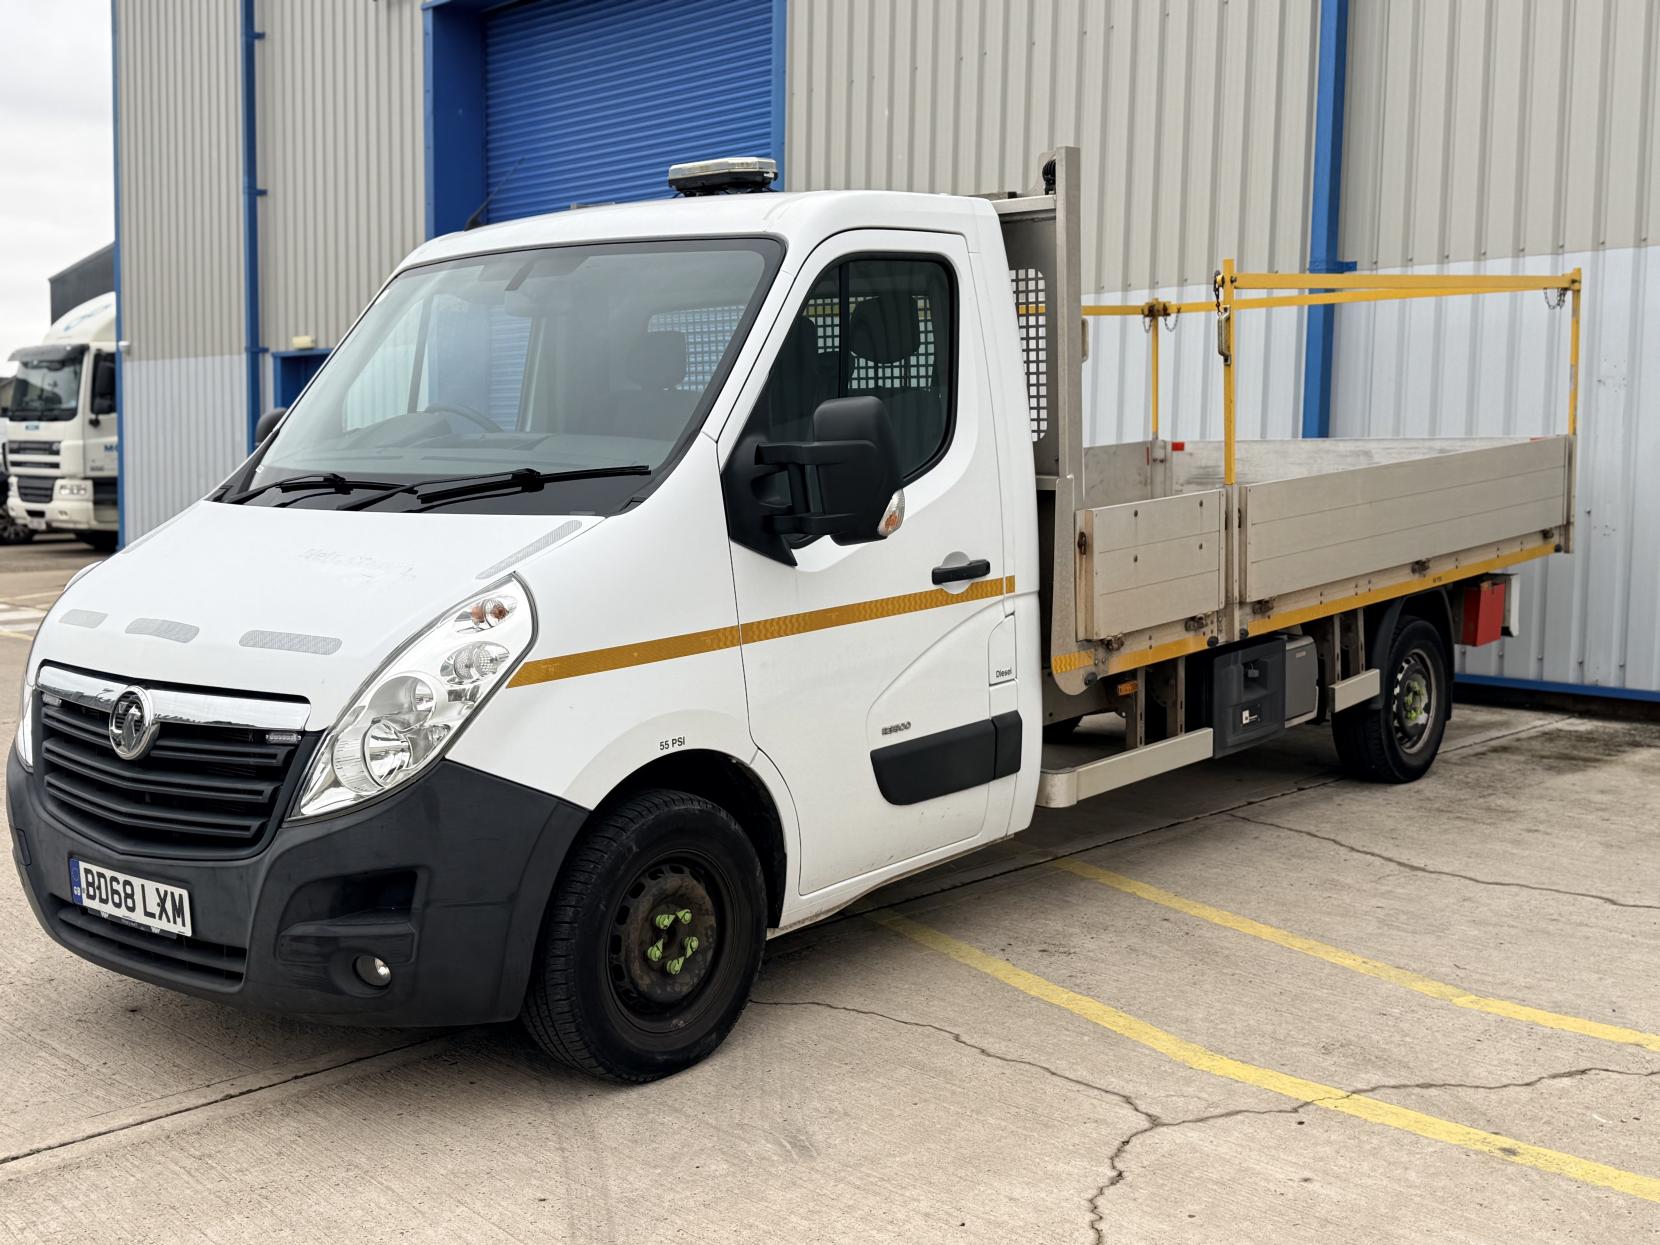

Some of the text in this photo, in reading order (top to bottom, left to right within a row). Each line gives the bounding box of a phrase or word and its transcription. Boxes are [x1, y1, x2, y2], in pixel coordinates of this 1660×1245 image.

[996, 667, 1012, 678] Diesel
[659, 736, 685, 750] 55 PSI
[74, 886, 81, 896] GB
[84, 867, 186, 927] BD68 LXM
